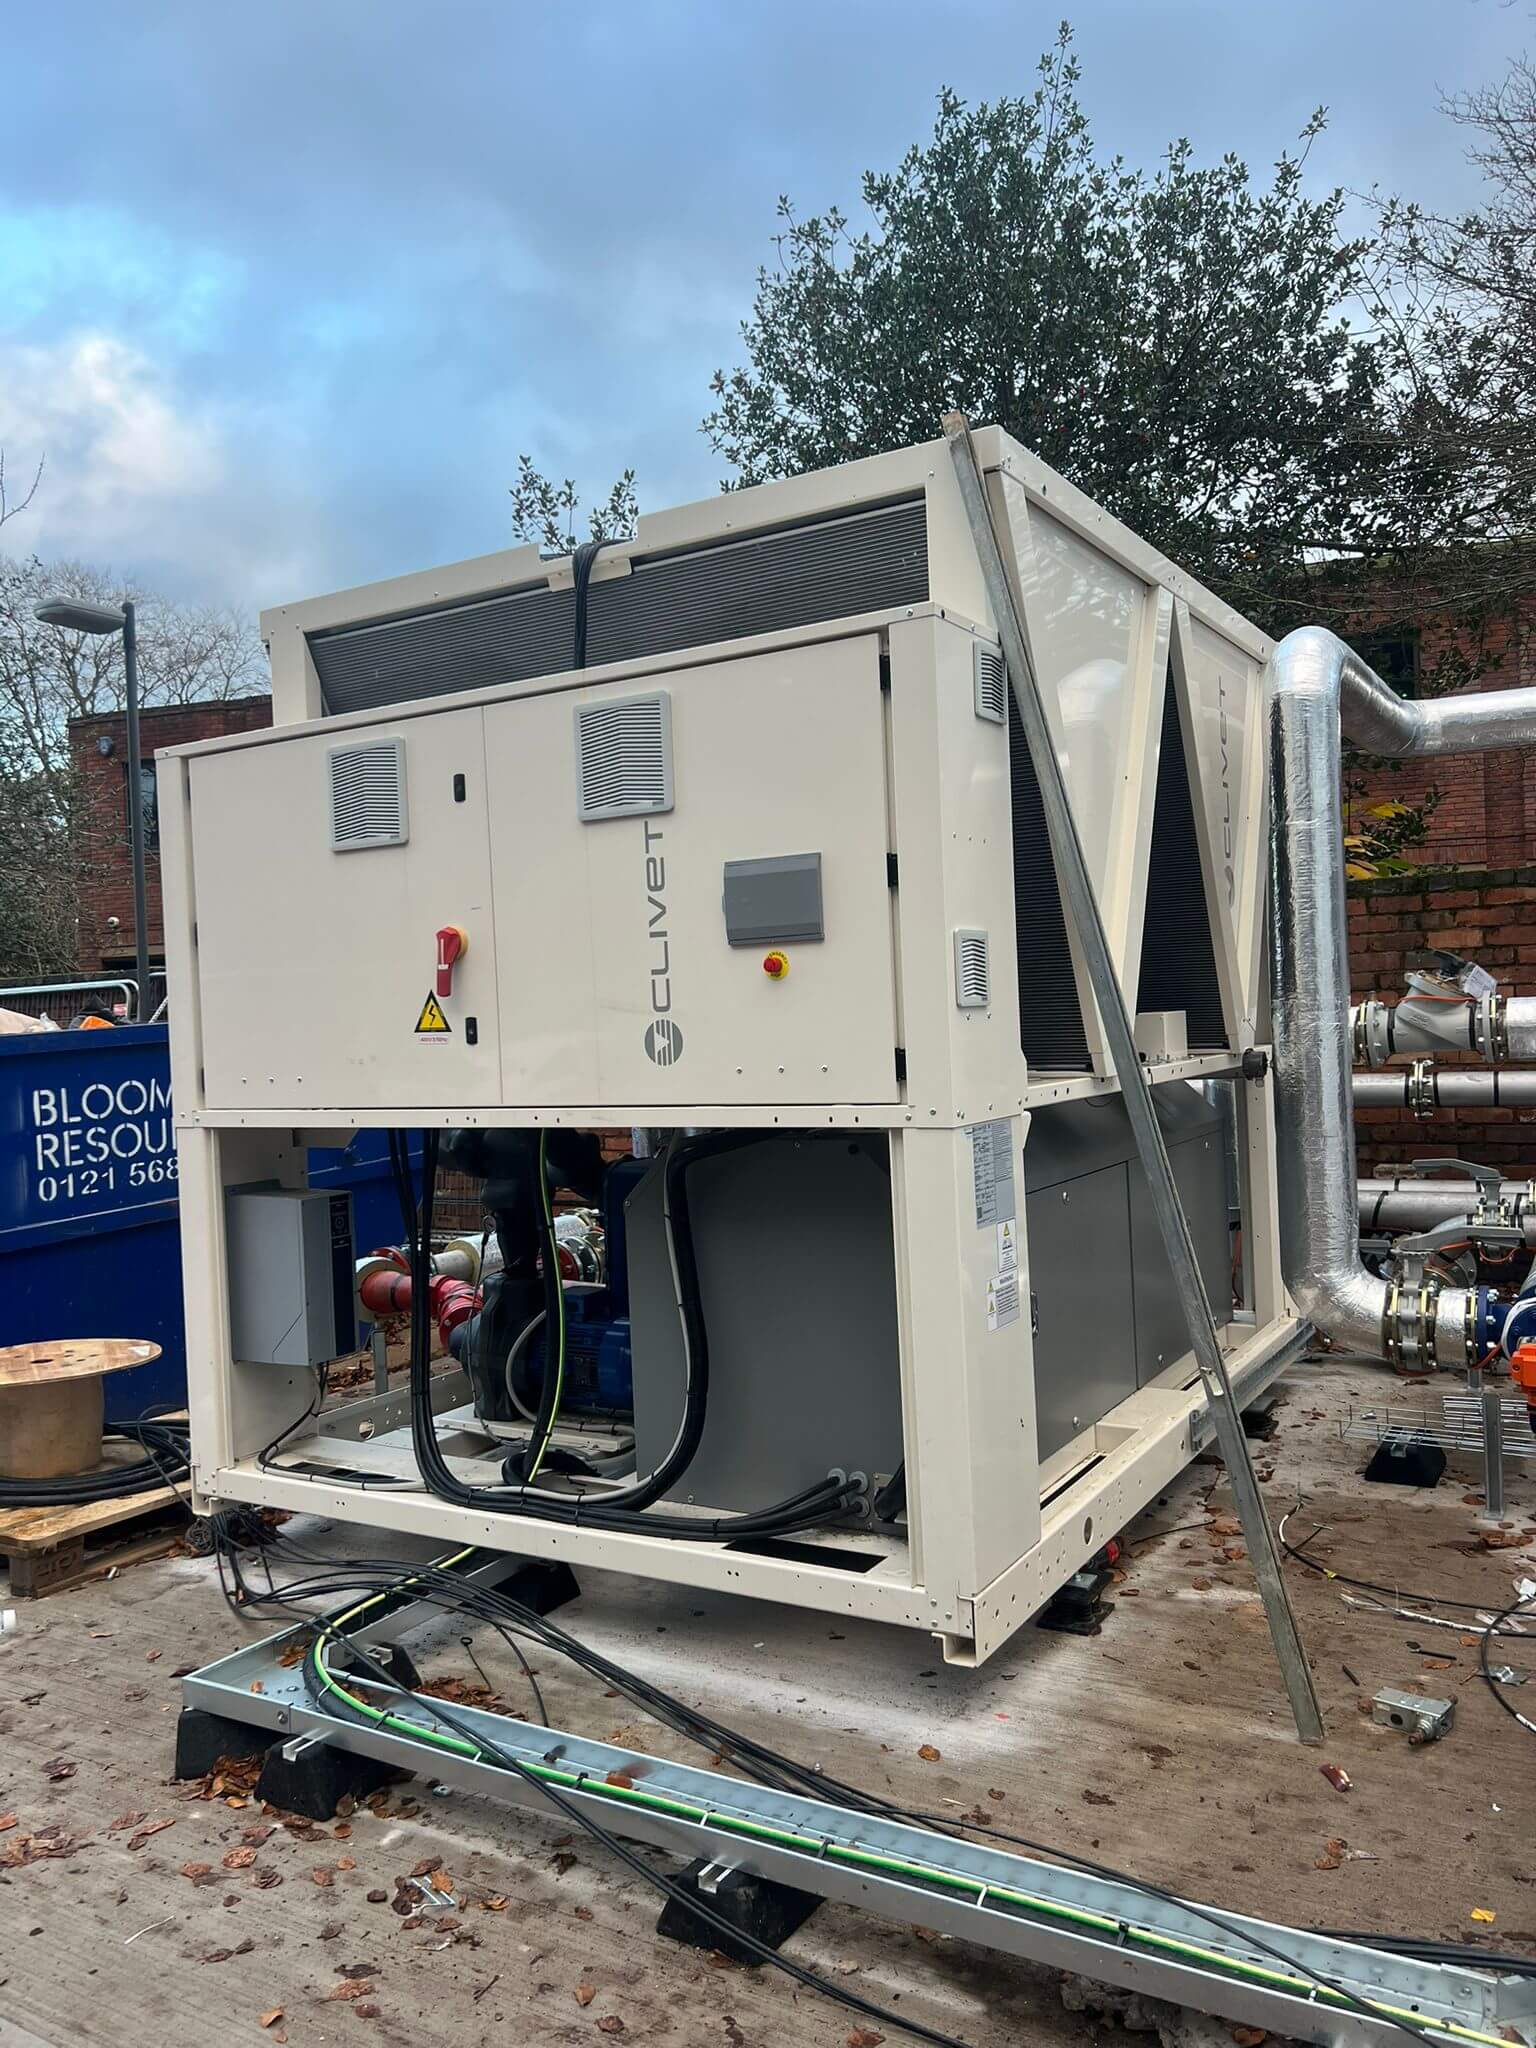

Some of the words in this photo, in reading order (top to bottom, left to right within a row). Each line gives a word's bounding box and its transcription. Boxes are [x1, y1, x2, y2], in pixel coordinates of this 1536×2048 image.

[36, 1118, 177, 1171] RESOU
[38, 1166, 115, 1202] 0121
[129, 1157, 179, 1187] 568
